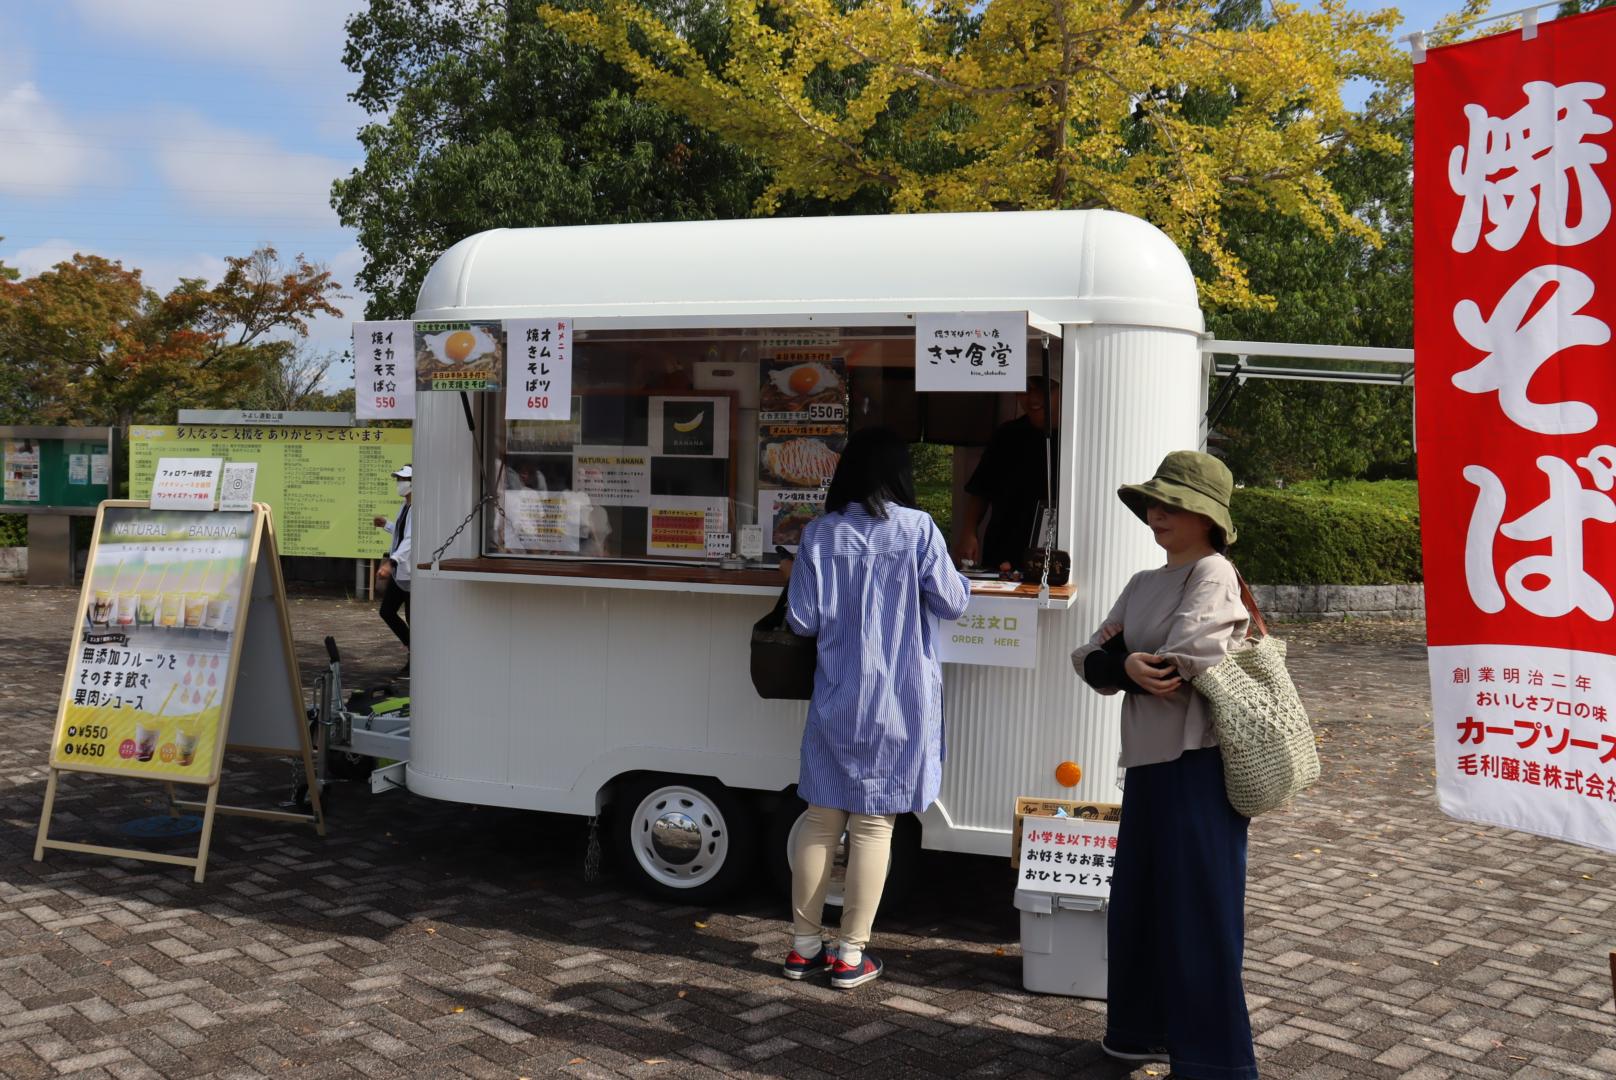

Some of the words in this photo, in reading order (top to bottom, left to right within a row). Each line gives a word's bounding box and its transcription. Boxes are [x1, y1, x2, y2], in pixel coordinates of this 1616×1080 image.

[372, 331, 384, 392] 焼きそば
[526, 328, 539, 392] 焼きそば
[539, 328, 551, 392] オムレツ
[928, 342, 1012, 367] きさ食堂
[1448, 81, 1616, 622] 焼そば
[376, 396, 395, 408] 550
[527, 396, 549, 408] 650
[810, 406, 843, 418] 550円
[268, 428, 384, 442] ありがとうございます
[114, 523, 167, 536] NATURAL
[188, 525, 238, 537] BANANA
[956, 616, 1017, 631] ご注文口
[952, 635, 984, 645] ORDER
[994, 638, 1020, 647] HERE
[82, 648, 177, 670] 無添加フルーツを
[80, 669, 151, 689] そのまま飲む
[1453, 667, 1591, 692] 創業明治二年
[74, 688, 144, 710] 果肉ジュース
[1476, 692, 1608, 723] おいしさプロの味
[1456, 716, 1616, 764] カープソース
[1028, 830, 1118, 849] 小学生以下対象
[1026, 848, 1116, 868] お好きなお菓子
